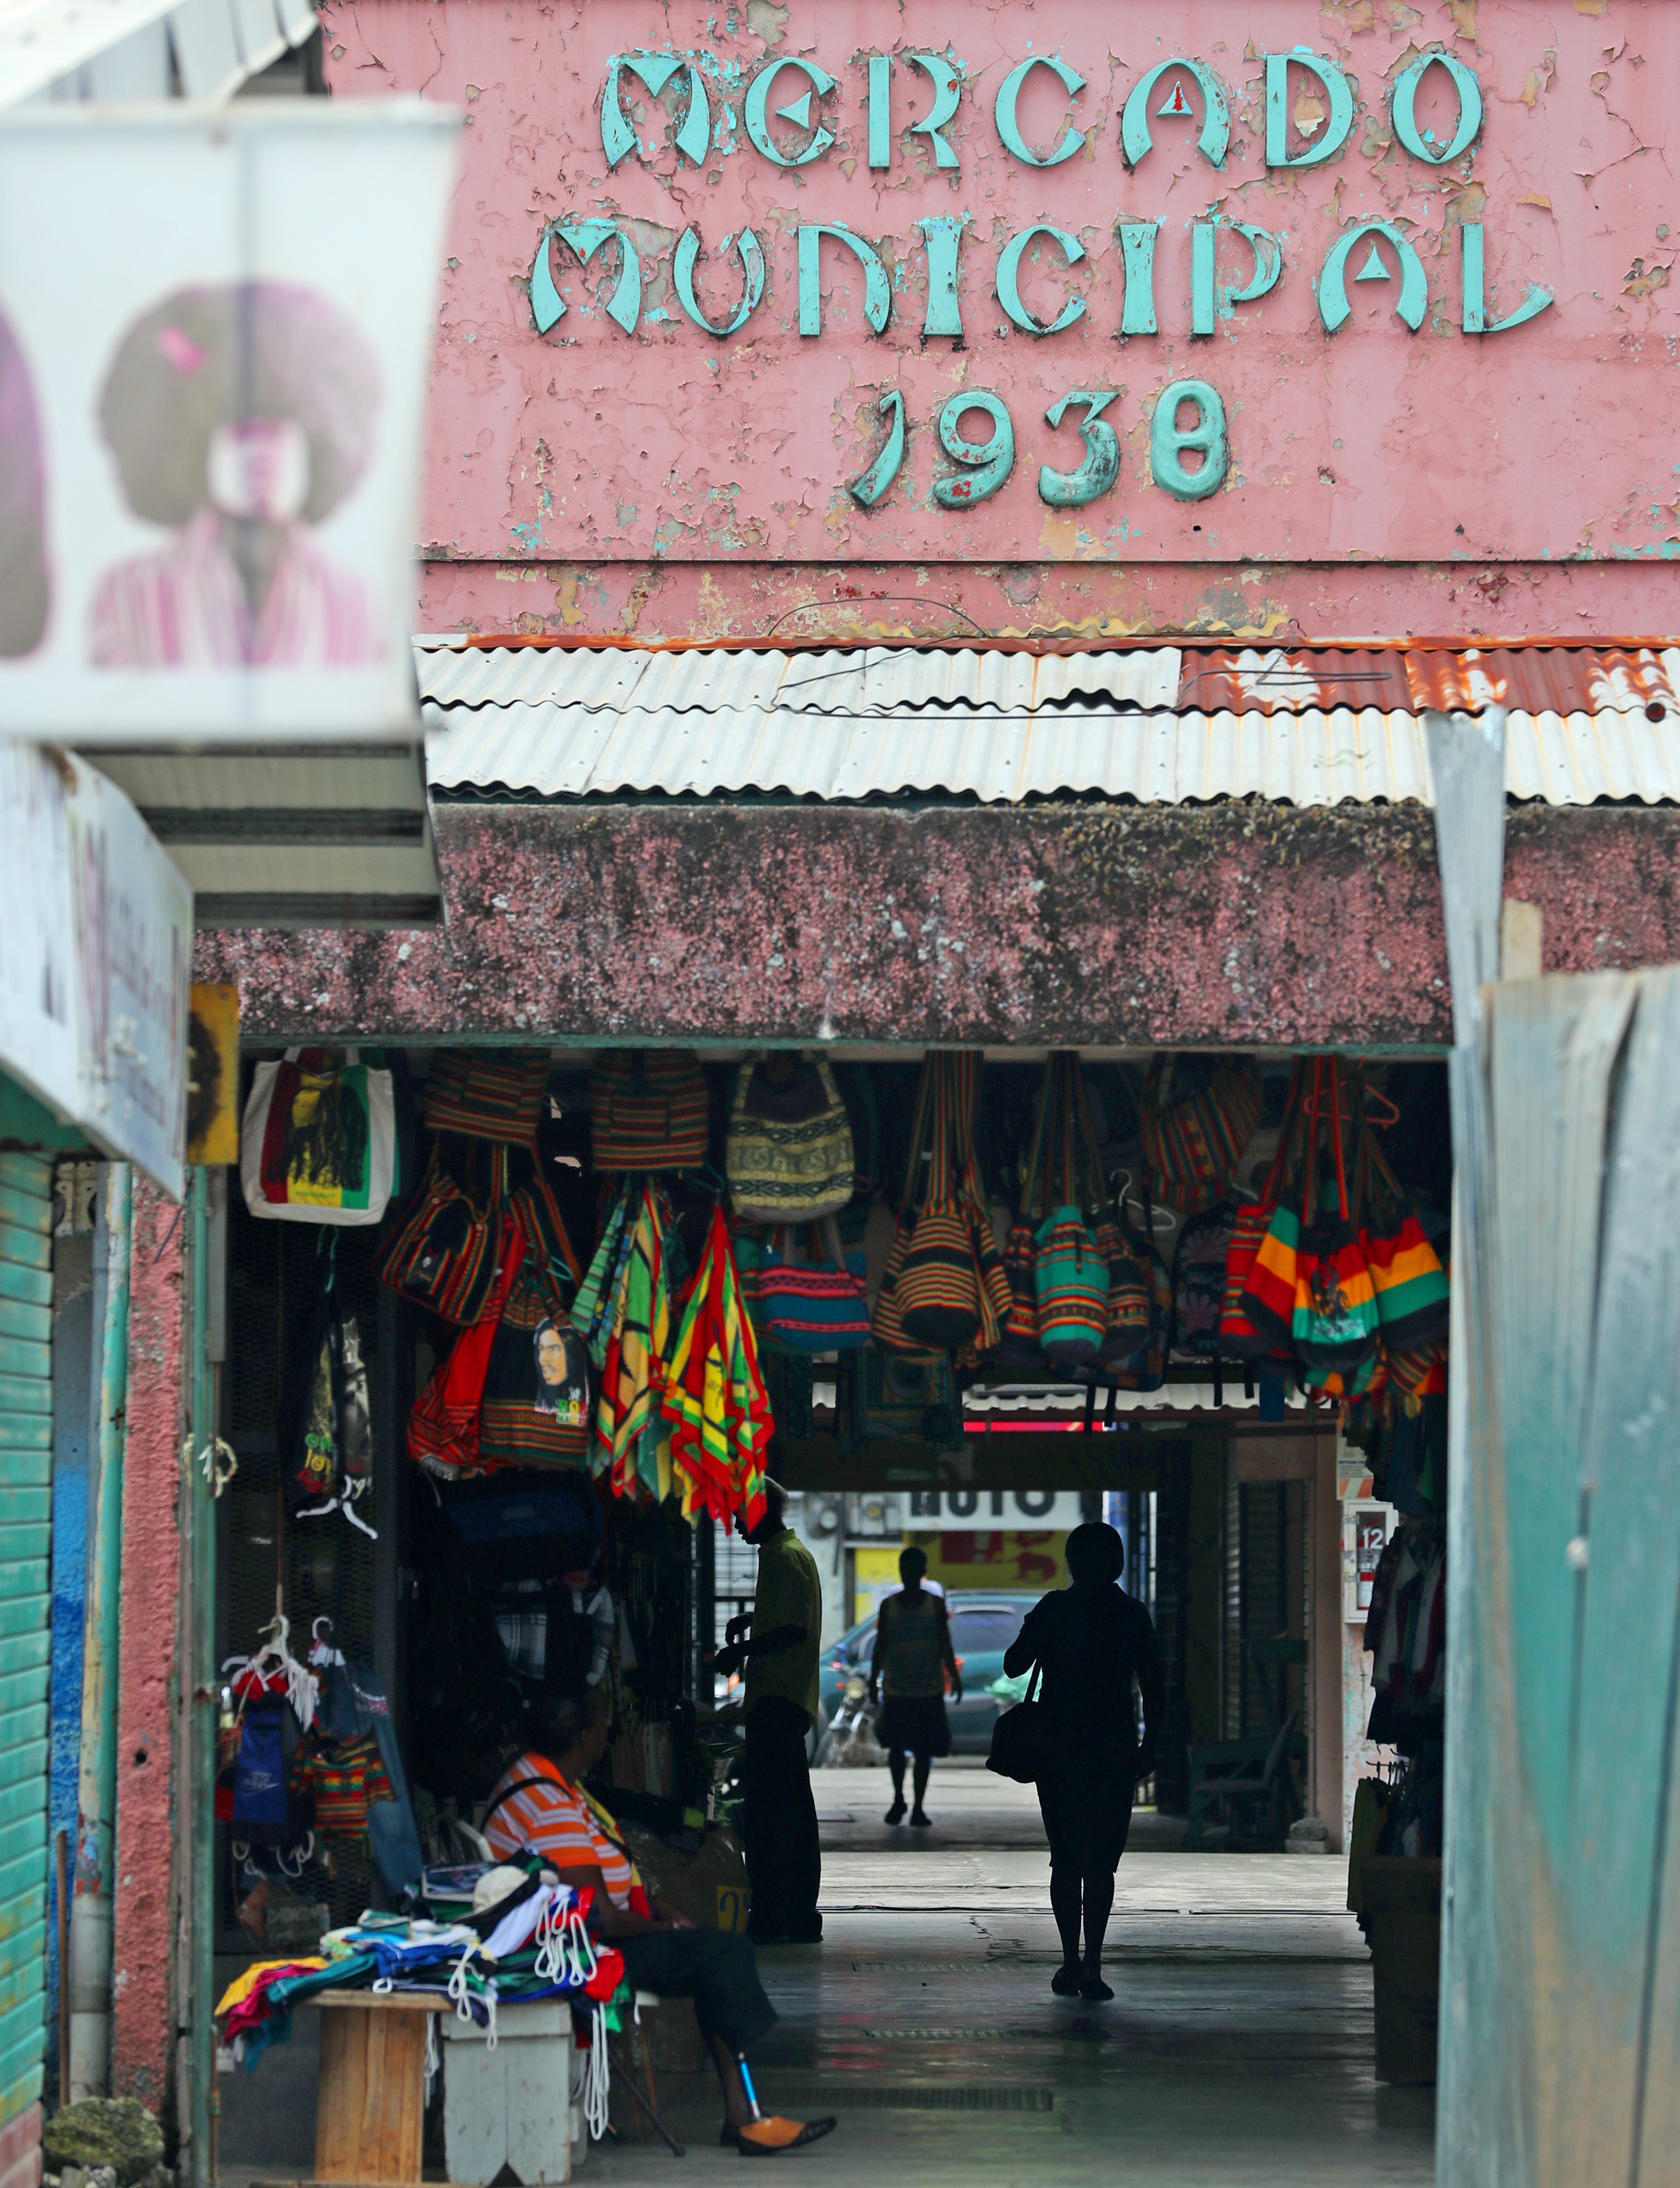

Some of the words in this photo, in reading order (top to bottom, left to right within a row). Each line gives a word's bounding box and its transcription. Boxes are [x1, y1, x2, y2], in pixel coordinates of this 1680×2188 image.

[601, 52, 1483, 169] MERCADO
[530, 217, 1554, 337] MUNICIPAL
[850, 379, 1229, 511] 1938
[1362, 1527, 1384, 1550] 12
